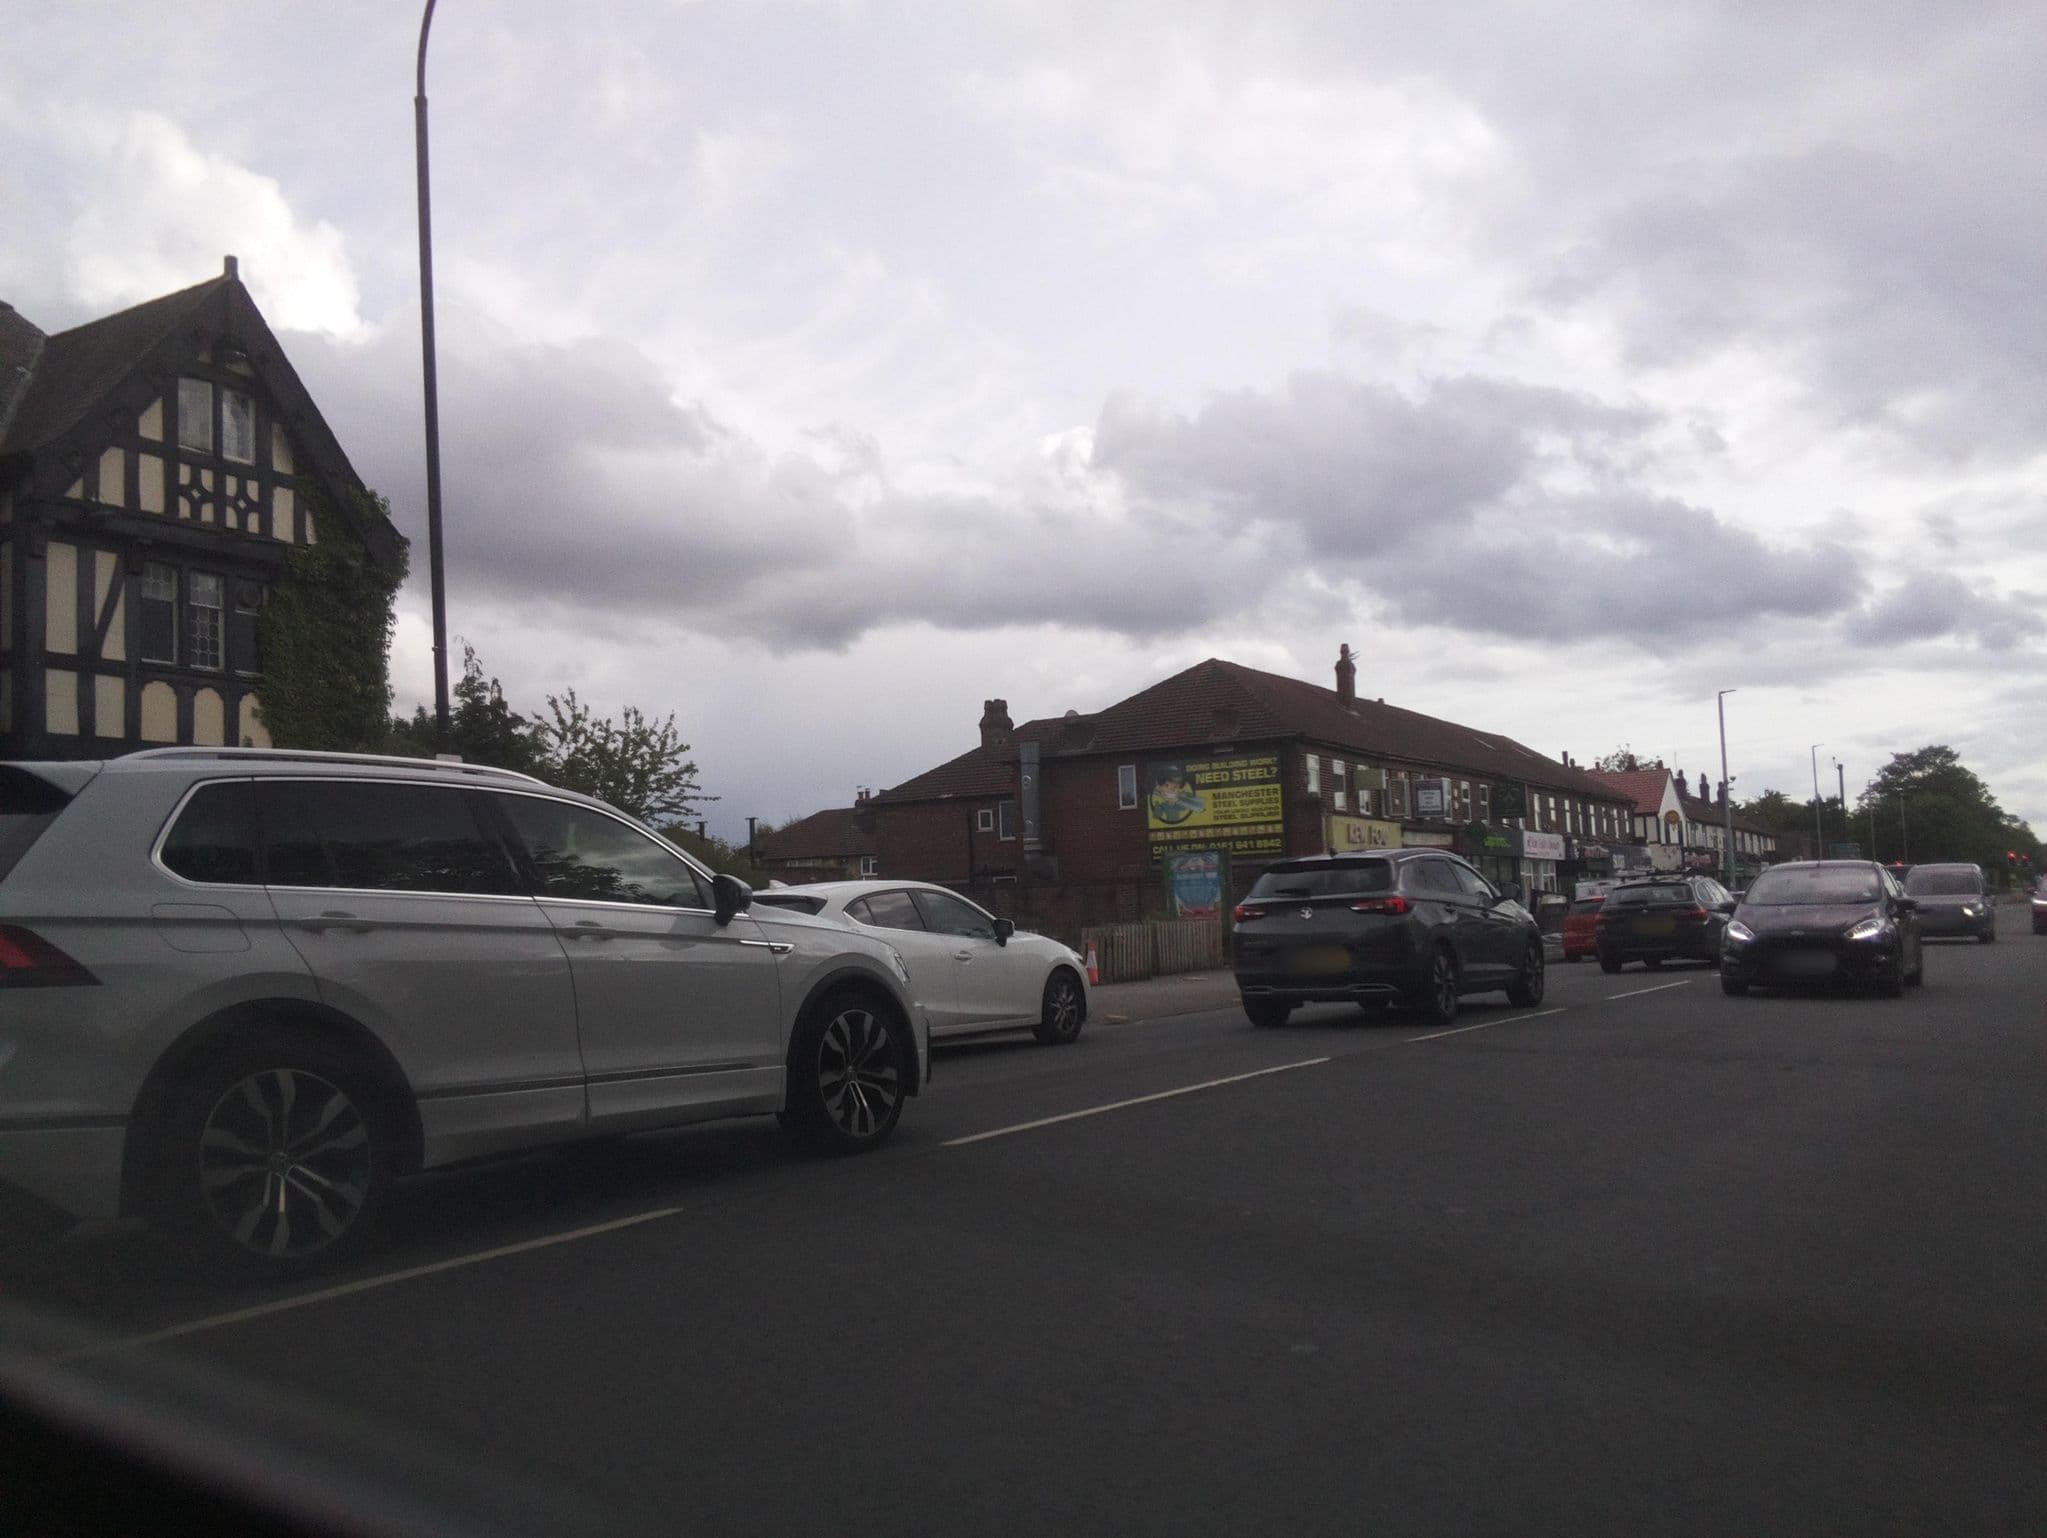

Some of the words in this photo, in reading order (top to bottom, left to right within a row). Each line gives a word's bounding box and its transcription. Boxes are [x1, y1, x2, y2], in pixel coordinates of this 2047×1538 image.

[1211, 760, 1248, 769] BUILDING
[1195, 771, 1229, 784] NEED
[1232, 767, 1278, 781] STEEL?
[1212, 788, 1279, 800] MANCHESTER
[1212, 800, 1237, 809] STEEL
[1239, 797, 1280, 807] SUPPLIES
